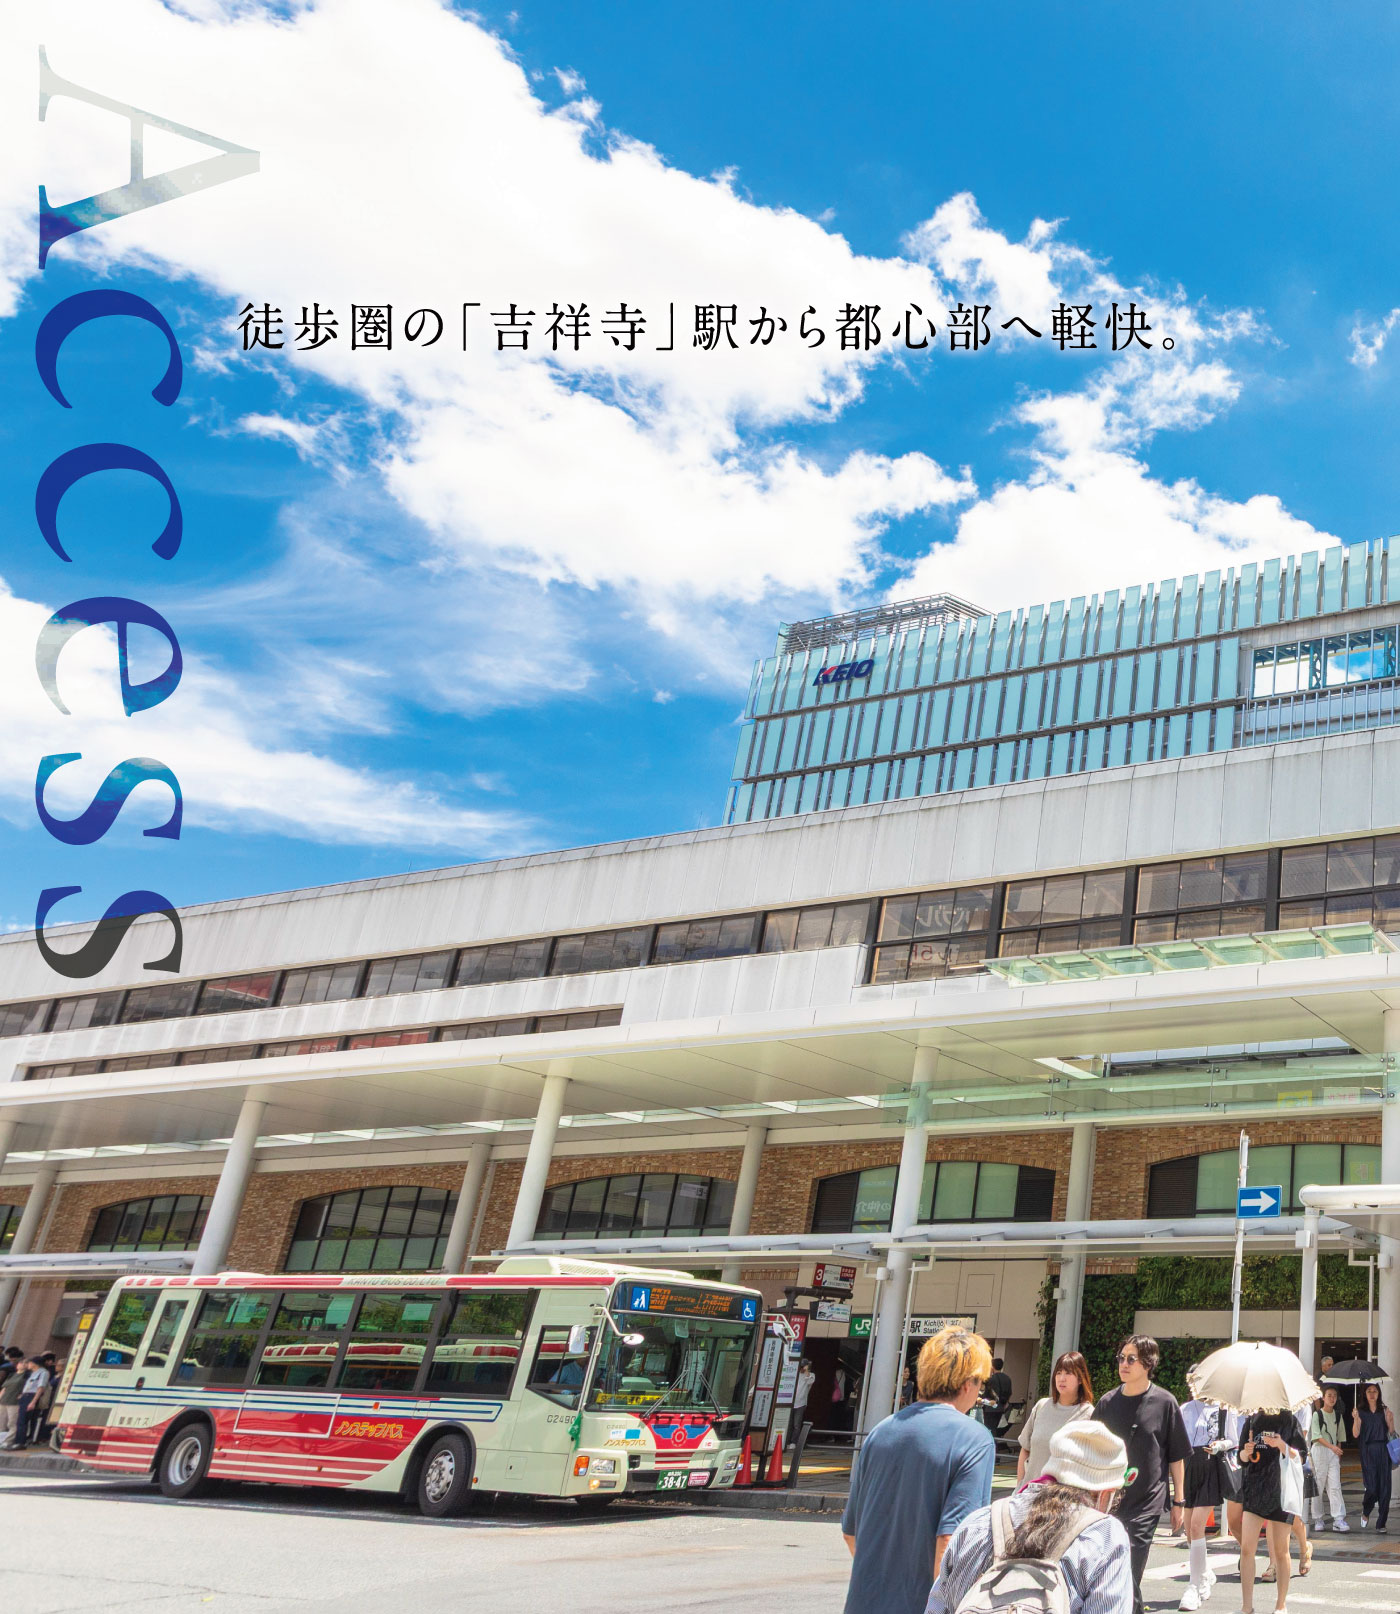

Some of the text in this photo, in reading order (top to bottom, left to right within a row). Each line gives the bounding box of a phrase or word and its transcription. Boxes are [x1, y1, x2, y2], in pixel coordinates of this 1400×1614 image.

[812, 659, 874, 686] KEIO
[816, 1269, 824, 1281] 3
[791, 1323, 801, 1339] 3
[855, 1319, 871, 1330] JR
[334, 1420, 404, 1439] ノンステップバス
